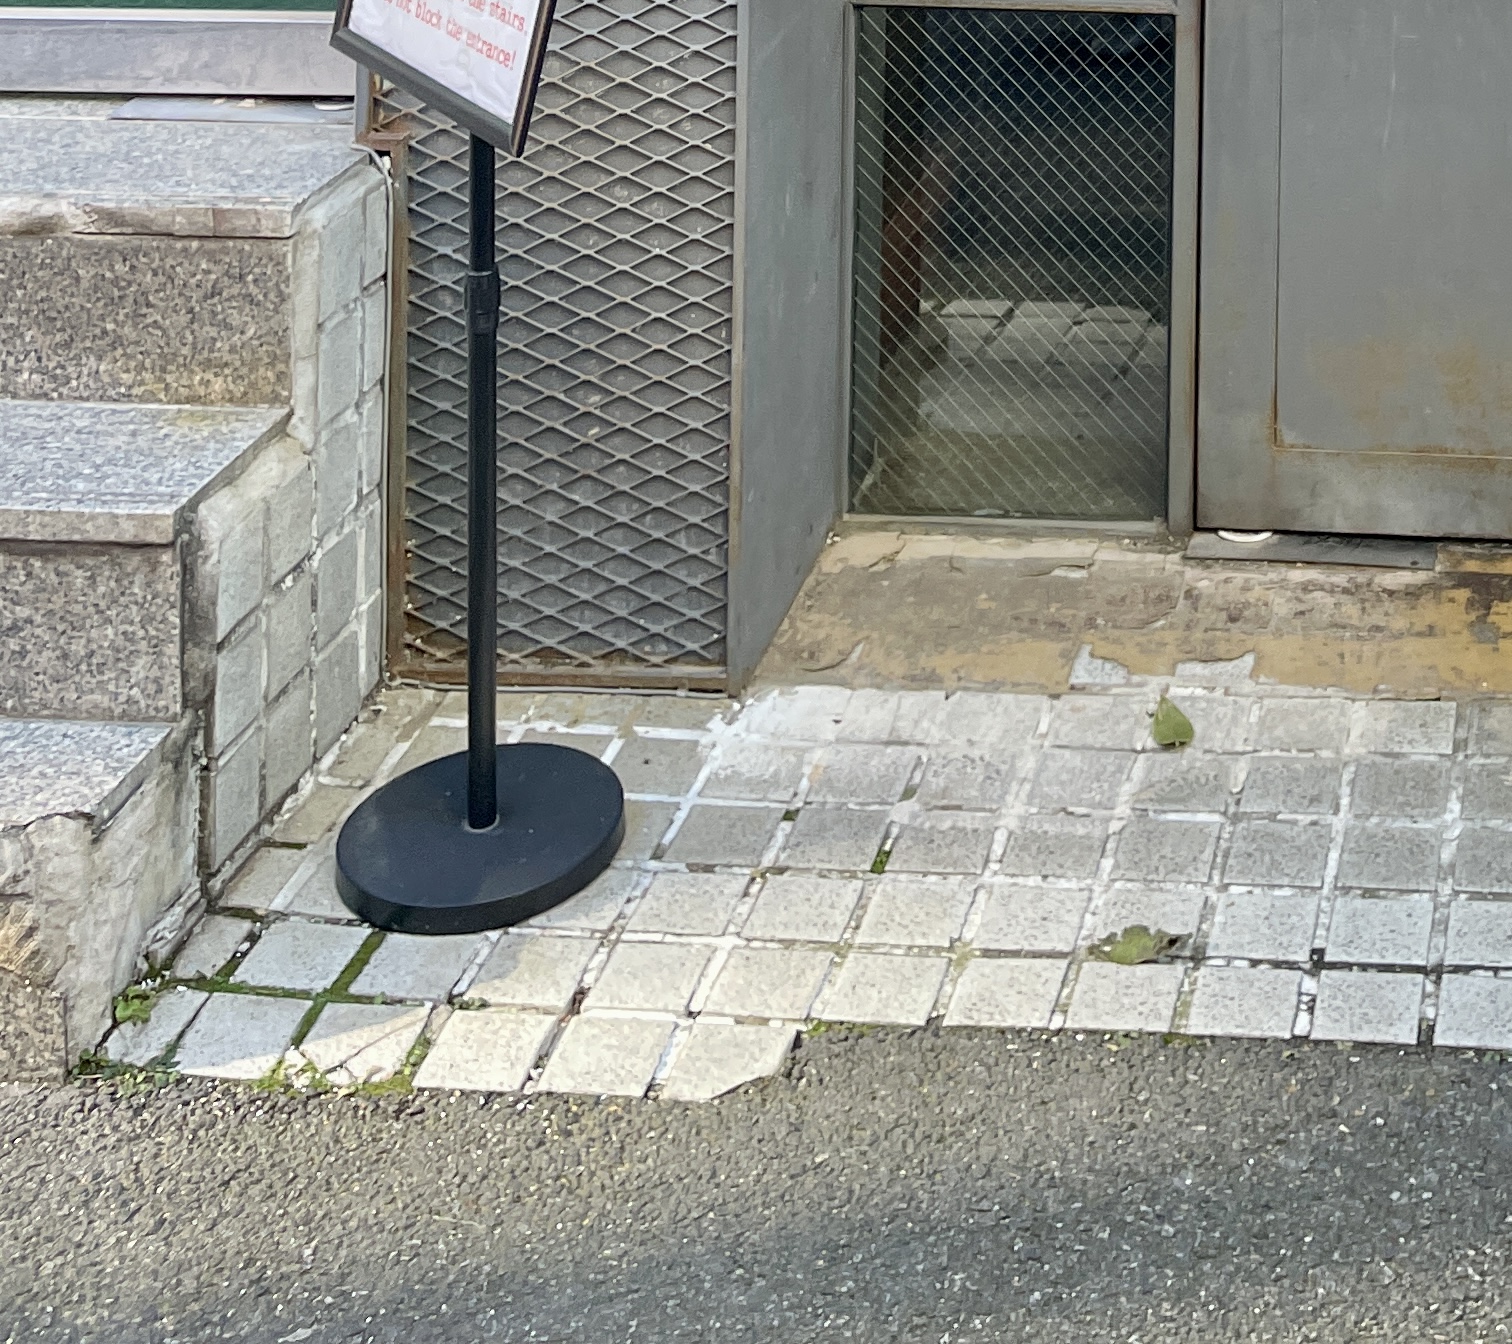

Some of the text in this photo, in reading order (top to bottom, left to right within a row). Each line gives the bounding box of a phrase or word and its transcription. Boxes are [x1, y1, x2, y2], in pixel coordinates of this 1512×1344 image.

[415, 0, 443, 30] block
[446, 17, 463, 41] the
[466, 31, 517, 70] entrance!
